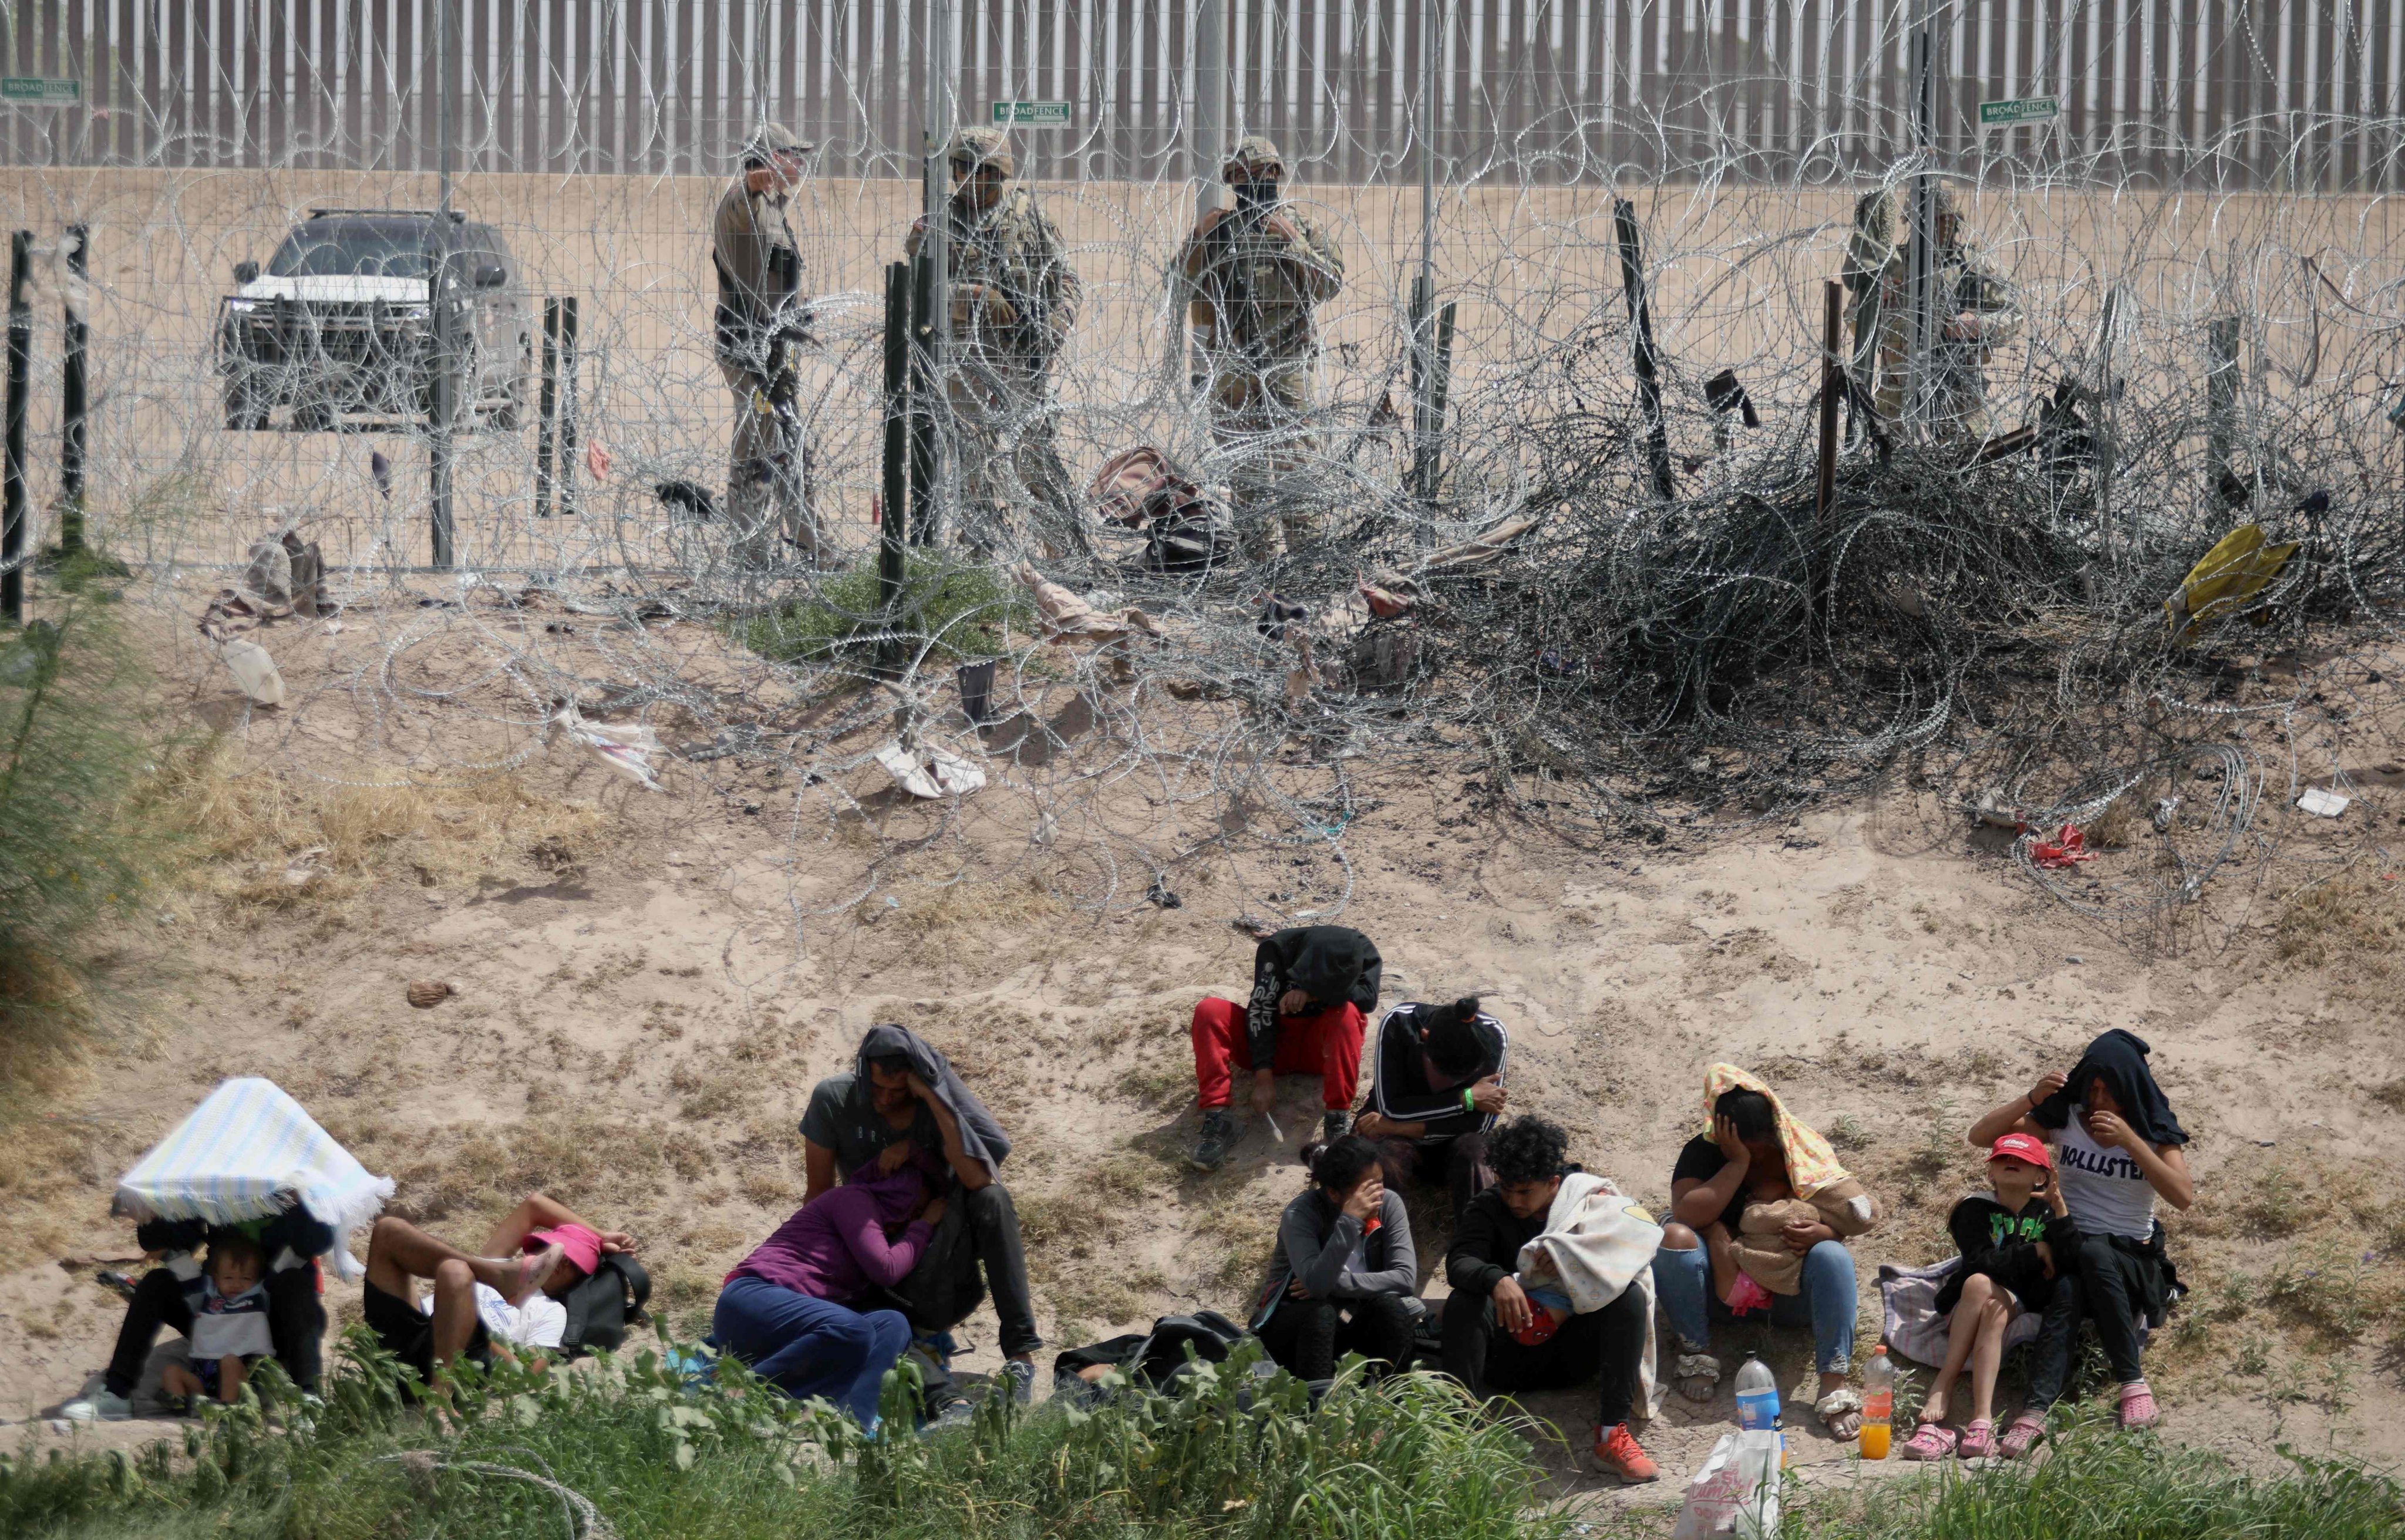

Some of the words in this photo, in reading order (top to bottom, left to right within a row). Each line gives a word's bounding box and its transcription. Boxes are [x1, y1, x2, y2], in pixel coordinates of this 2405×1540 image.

[8, 83, 75, 93] BROADFENCE
[1000, 107, 1064, 116] BROADFENCE
[1986, 102, 2052, 116] BROADFENCE
[1249, 985, 1266, 1037] GAME
[1261, 976, 1280, 1026] SQUID
[2060, 1144, 2147, 1181] HOLLISTE
